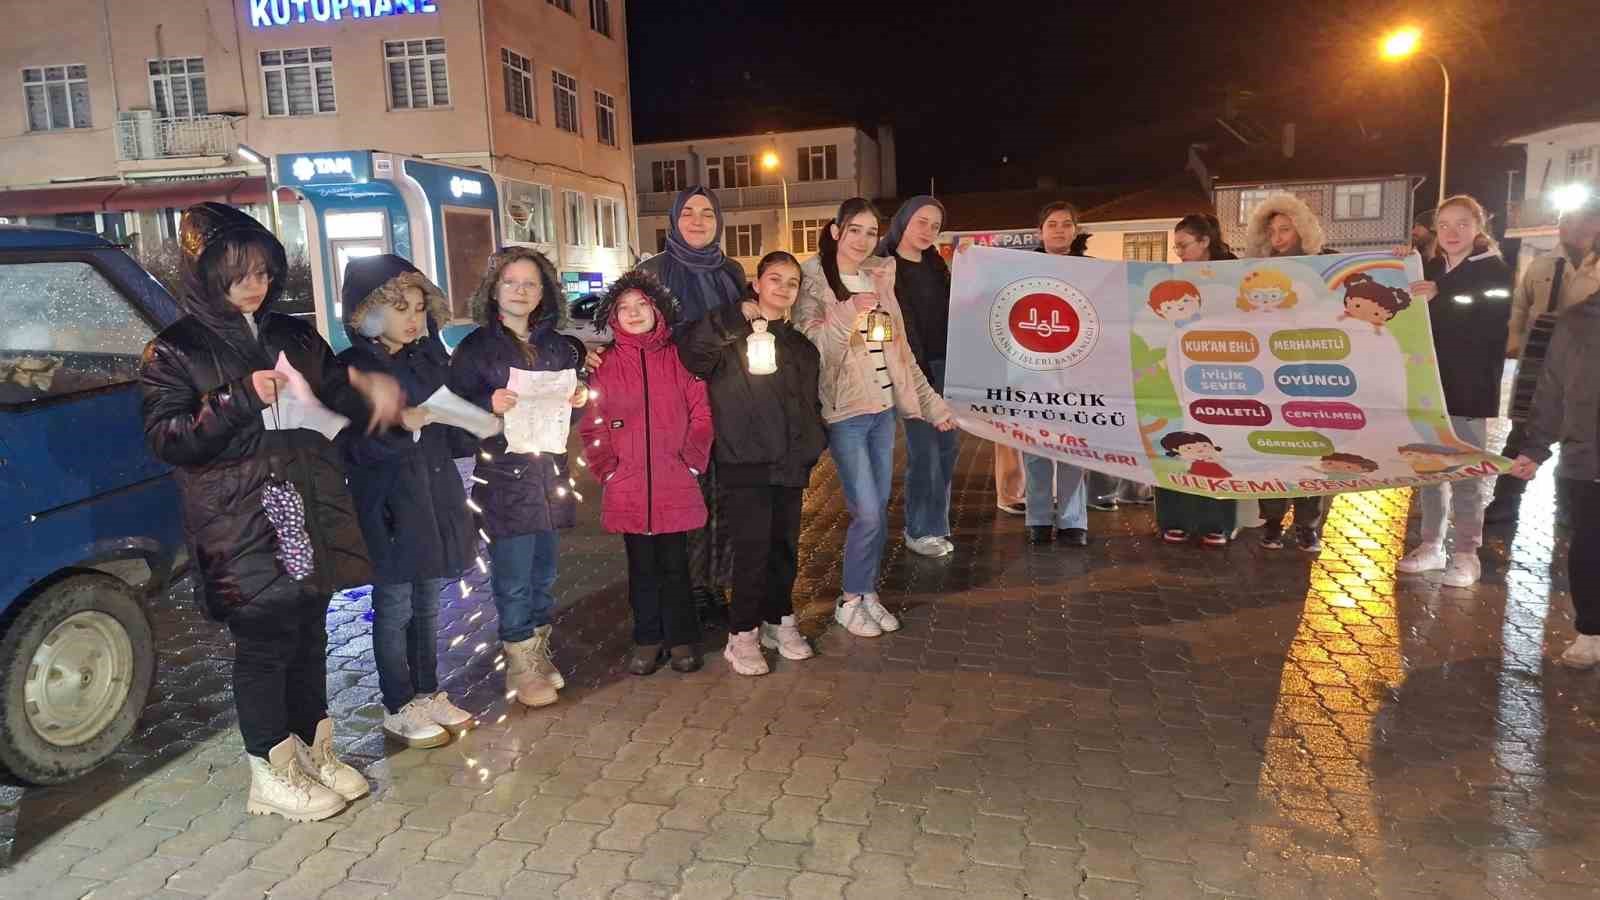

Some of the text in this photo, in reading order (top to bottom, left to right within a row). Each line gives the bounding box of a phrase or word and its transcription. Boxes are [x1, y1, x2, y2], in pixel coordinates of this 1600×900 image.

[979, 233, 1000, 247] AK
[1185, 338, 1255, 353] KUR'AN EHLİ
[1274, 335, 1344, 350] MERHAMETLİ
[1200, 368, 1244, 380] İYİLİK
[1278, 374, 1351, 387] OYUNCU
[1200, 381, 1247, 391] SEVER
[986, 386, 1106, 408] HİSARCIK
[970, 403, 1126, 428] MÜFTÜLÜĞÜ
[1195, 405, 1267, 417] ADALETLİ
[1285, 409, 1363, 421] CENTİLMEN
